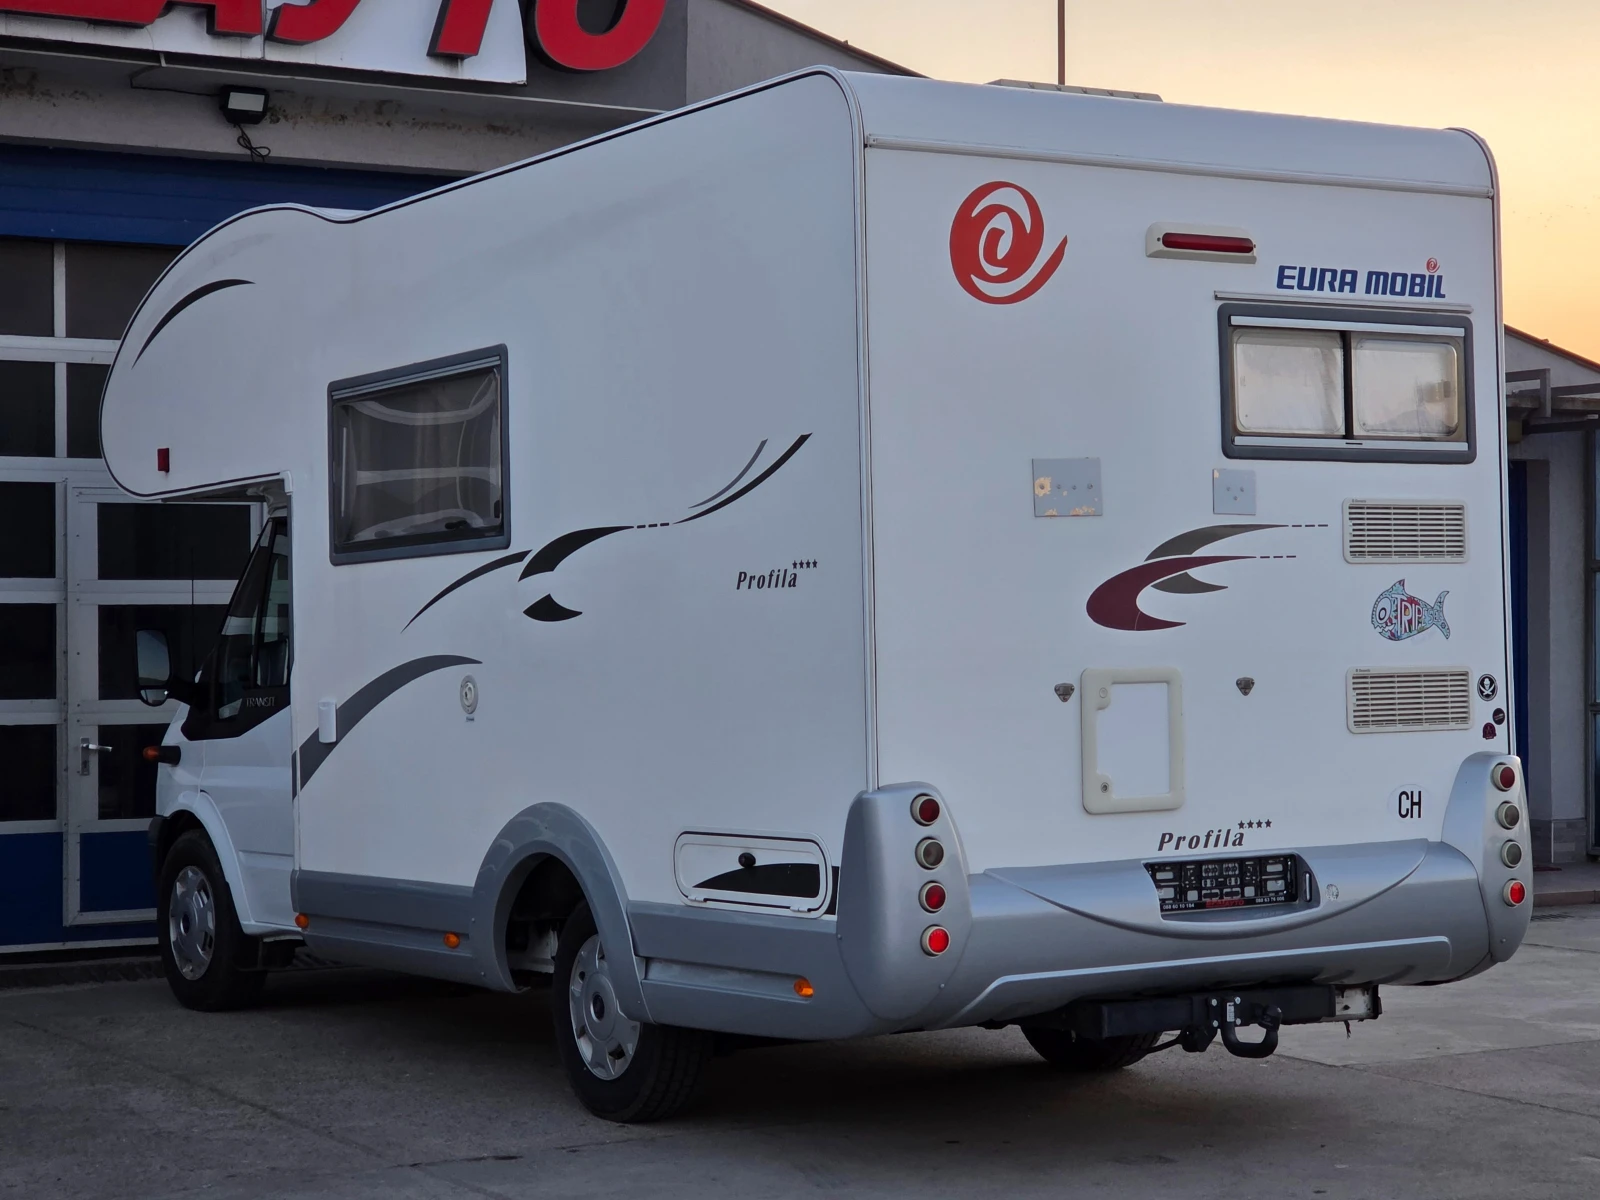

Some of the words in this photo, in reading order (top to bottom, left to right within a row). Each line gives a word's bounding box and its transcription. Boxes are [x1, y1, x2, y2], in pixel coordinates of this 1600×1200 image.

[1276, 264, 1359, 294] EURA
[1364, 270, 1446, 299] MOBIL
[736, 568, 798, 591] Profila
[246, 696, 276, 708] TRANSIT
[1398, 790, 1422, 819] CH
[1157, 828, 1245, 852] Profila
